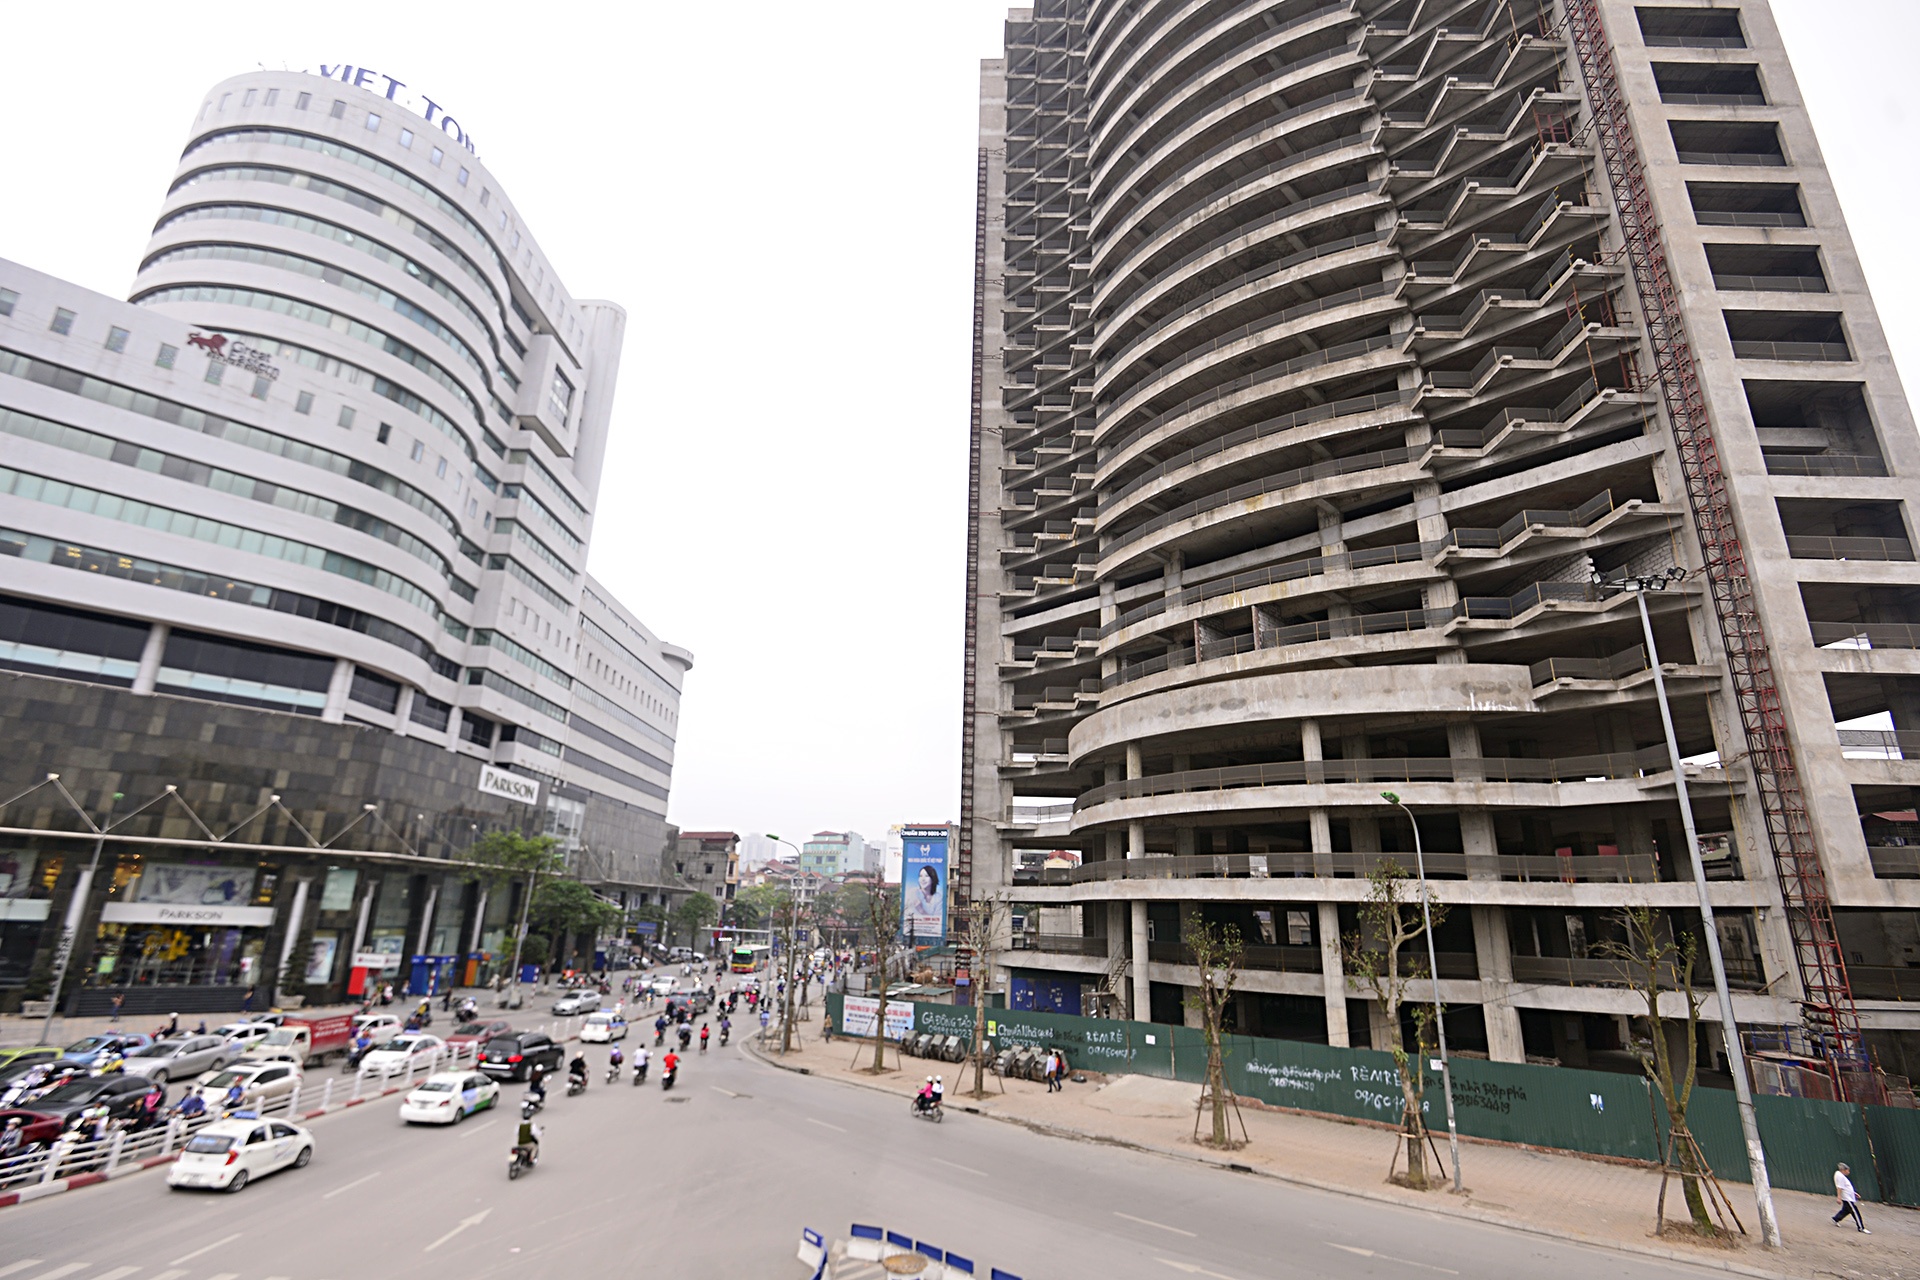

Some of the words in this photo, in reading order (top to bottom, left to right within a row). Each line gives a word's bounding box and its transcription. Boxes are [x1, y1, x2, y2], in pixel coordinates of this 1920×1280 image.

[484, 771, 535, 799] PARKSON
[1746, 836, 1758, 852] 2
[159, 908, 224, 920] PARKSON
